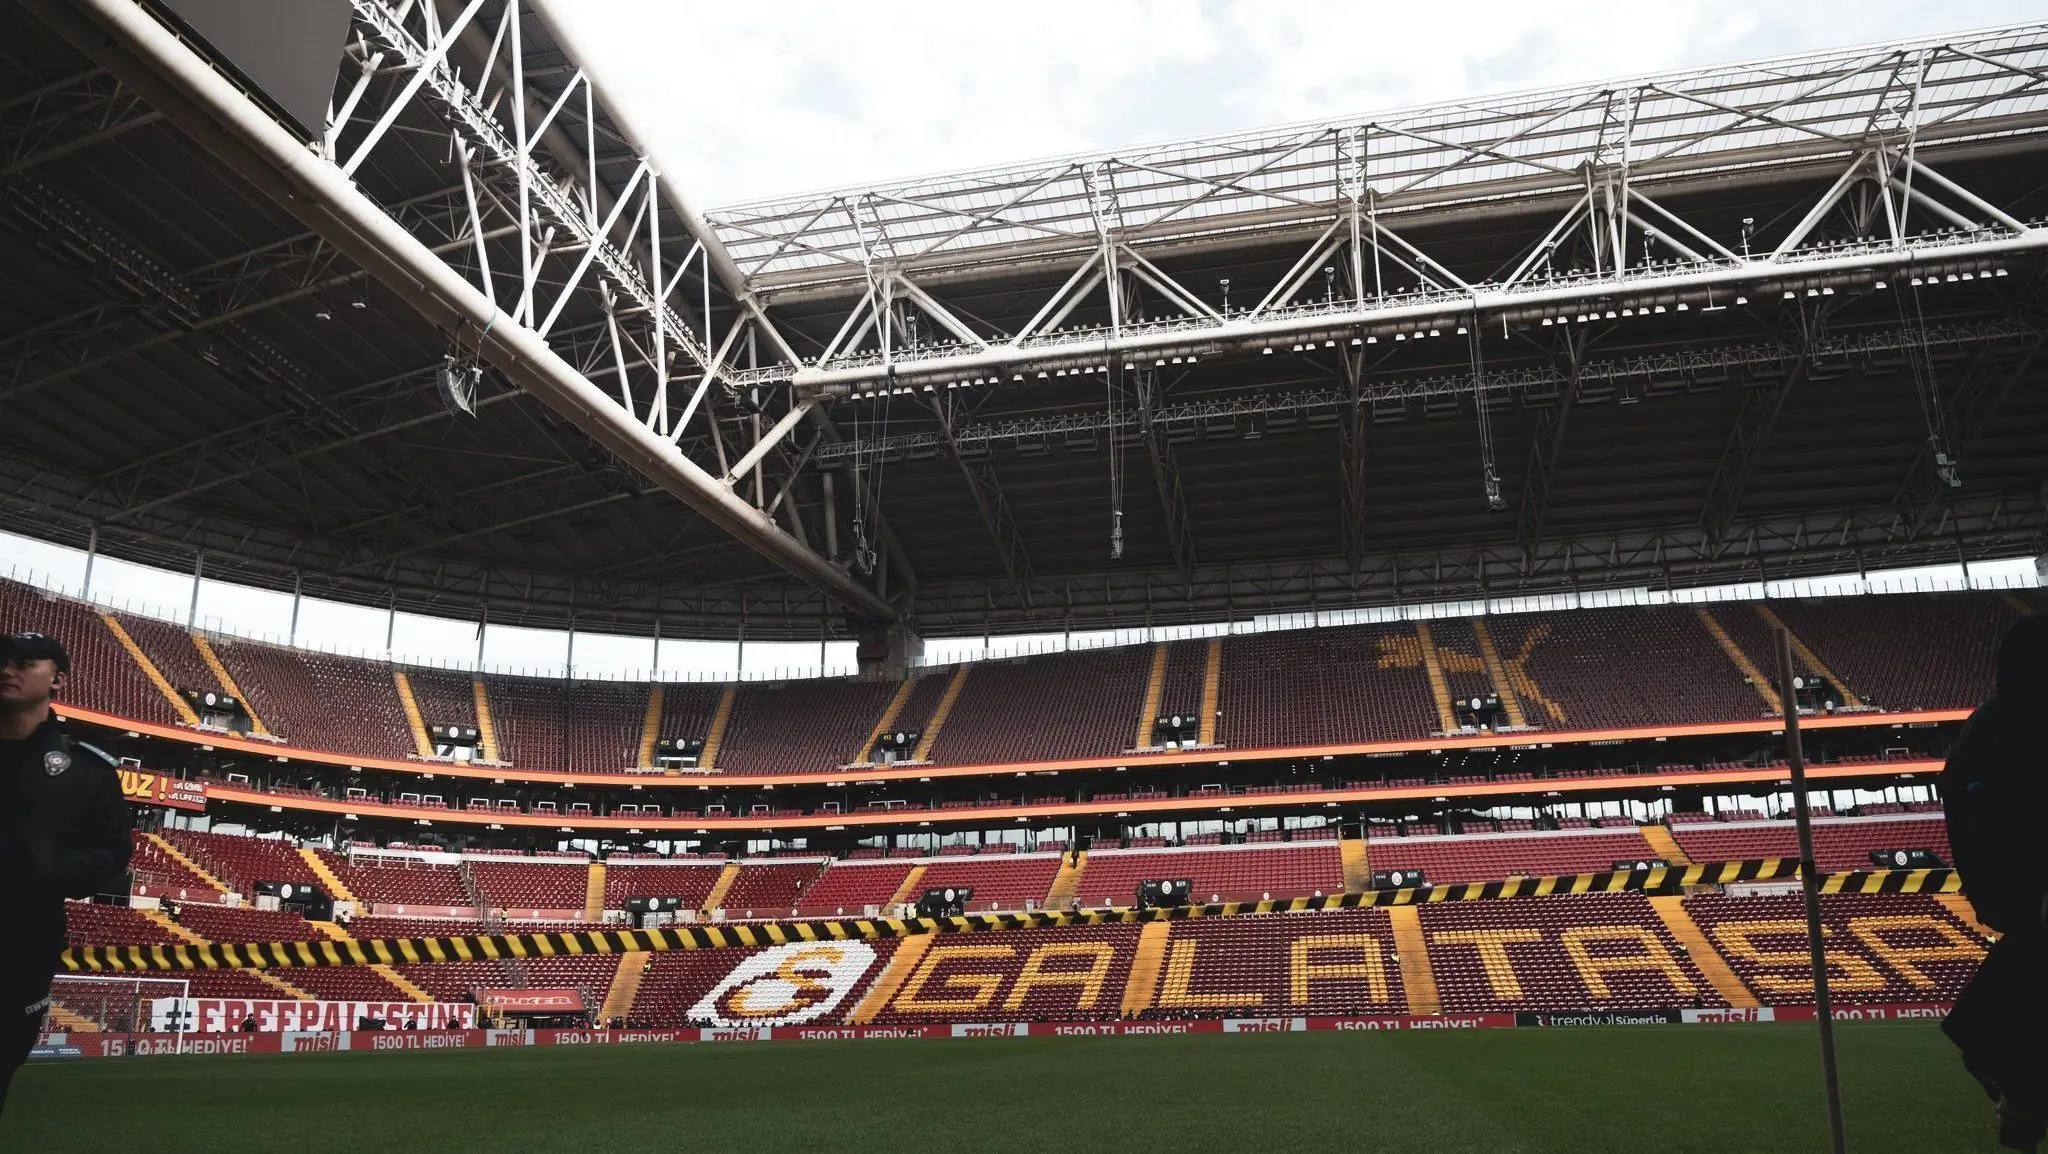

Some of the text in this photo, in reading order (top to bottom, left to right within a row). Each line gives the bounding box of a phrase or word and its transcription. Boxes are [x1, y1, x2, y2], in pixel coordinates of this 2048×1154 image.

[1697, 1008, 1759, 1023] misli
[964, 1024, 1017, 1037] misli
[1054, 1025, 1097, 1036] 1500
[1237, 1019, 1293, 1032] misli
[1334, 1020, 1380, 1031] 1500
[294, 1031, 341, 1051] misli
[495, 1028, 527, 1046] misli
[712, 1027, 760, 1041] misli
[799, 1029, 838, 1040] 1500
[101, 1038, 151, 1056] 150
[372, 1035, 403, 1049] 1500
[406, 1035, 421, 1049] TL
